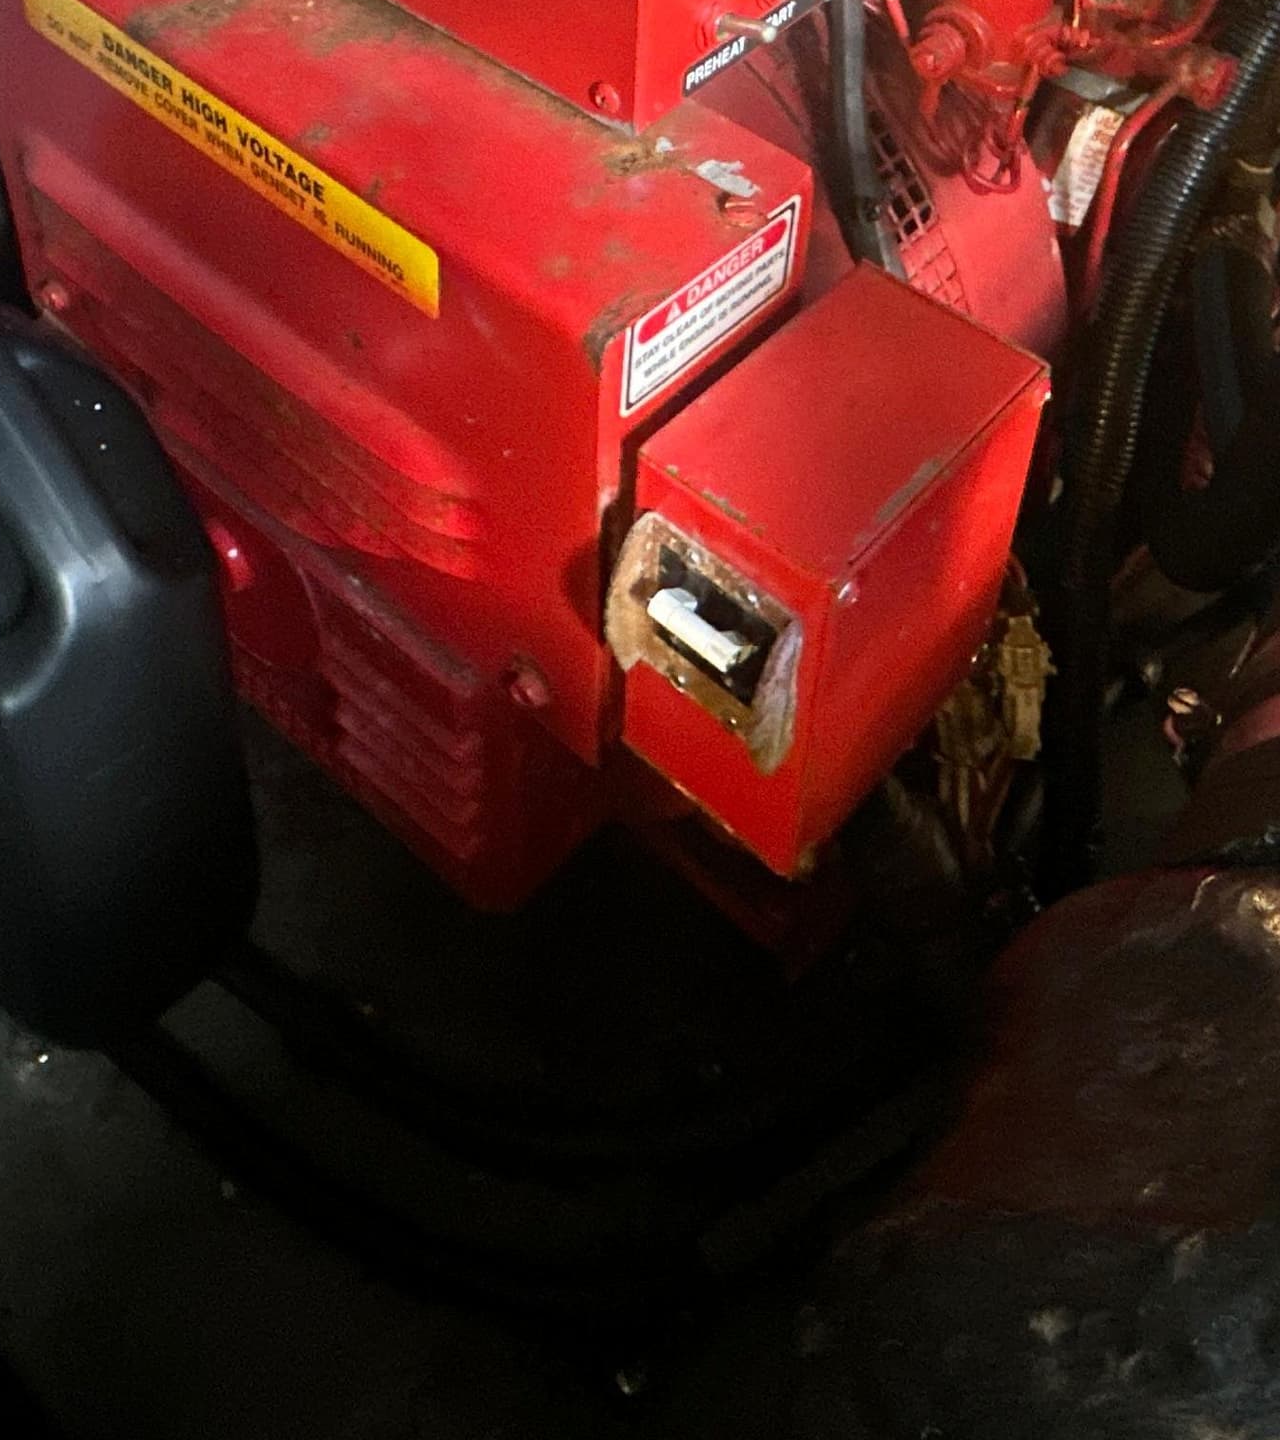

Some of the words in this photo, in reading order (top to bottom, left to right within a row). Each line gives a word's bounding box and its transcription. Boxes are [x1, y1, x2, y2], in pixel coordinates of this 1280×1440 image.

[685, 35, 746, 90] PREHEAT
[765, 0, 797, 27] ART
[97, 51, 150, 97] REMOVE
[154, 90, 199, 133] COVER
[204, 127, 245, 167] WHEN
[313, 205, 328, 227] IS
[334, 220, 405, 282] RUNNING
[102, 32, 174, 96] DANGER
[181, 87, 228, 134] HIGH
[237, 126, 326, 205] VOLTAGE
[634, 343, 661, 371] STAY
[662, 314, 698, 348] CLEAR
[699, 302, 714, 322] OF
[755, 248, 786, 276] PARTS
[686, 236, 766, 308] DANGER
[643, 348, 676, 378] WHILE
[678, 319, 716, 351] ENGINE
